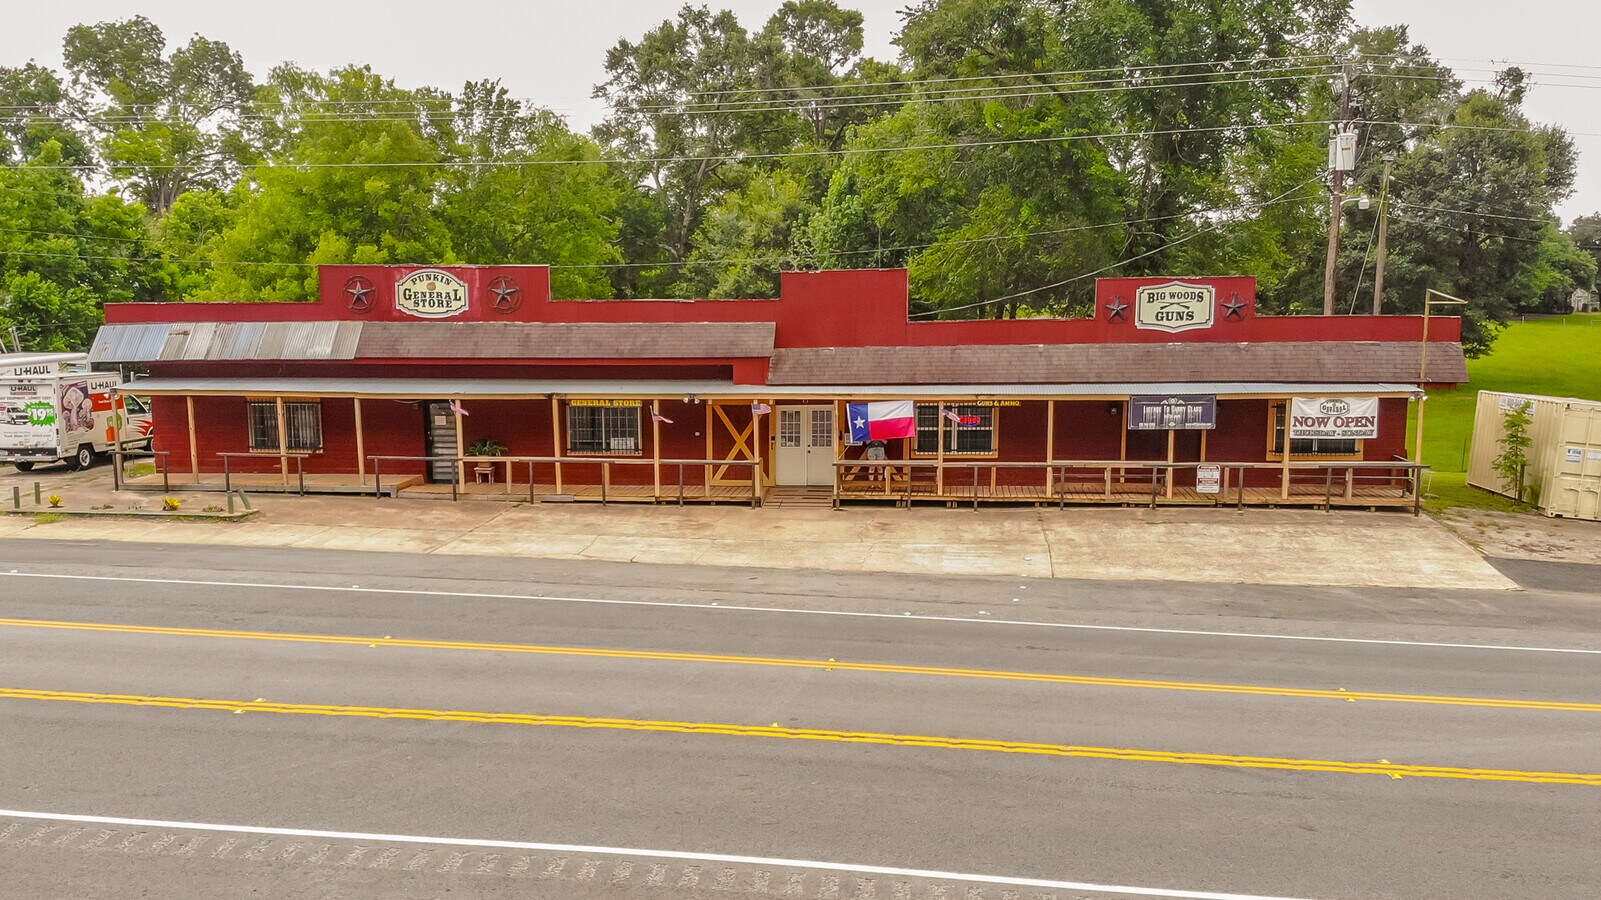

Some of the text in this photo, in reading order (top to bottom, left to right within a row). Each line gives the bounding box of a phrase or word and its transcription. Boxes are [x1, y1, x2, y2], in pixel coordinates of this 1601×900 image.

[410, 274, 452, 286] PUNKIN
[403, 288, 462, 301] GENERAL
[1146, 291, 1204, 303] BIG WOODS
[413, 299, 452, 308] STORE
[1155, 311, 1194, 321] GUNS
[14, 365, 51, 376] U-HAUL
[1292, 416, 1376, 428] NOW OPEN
